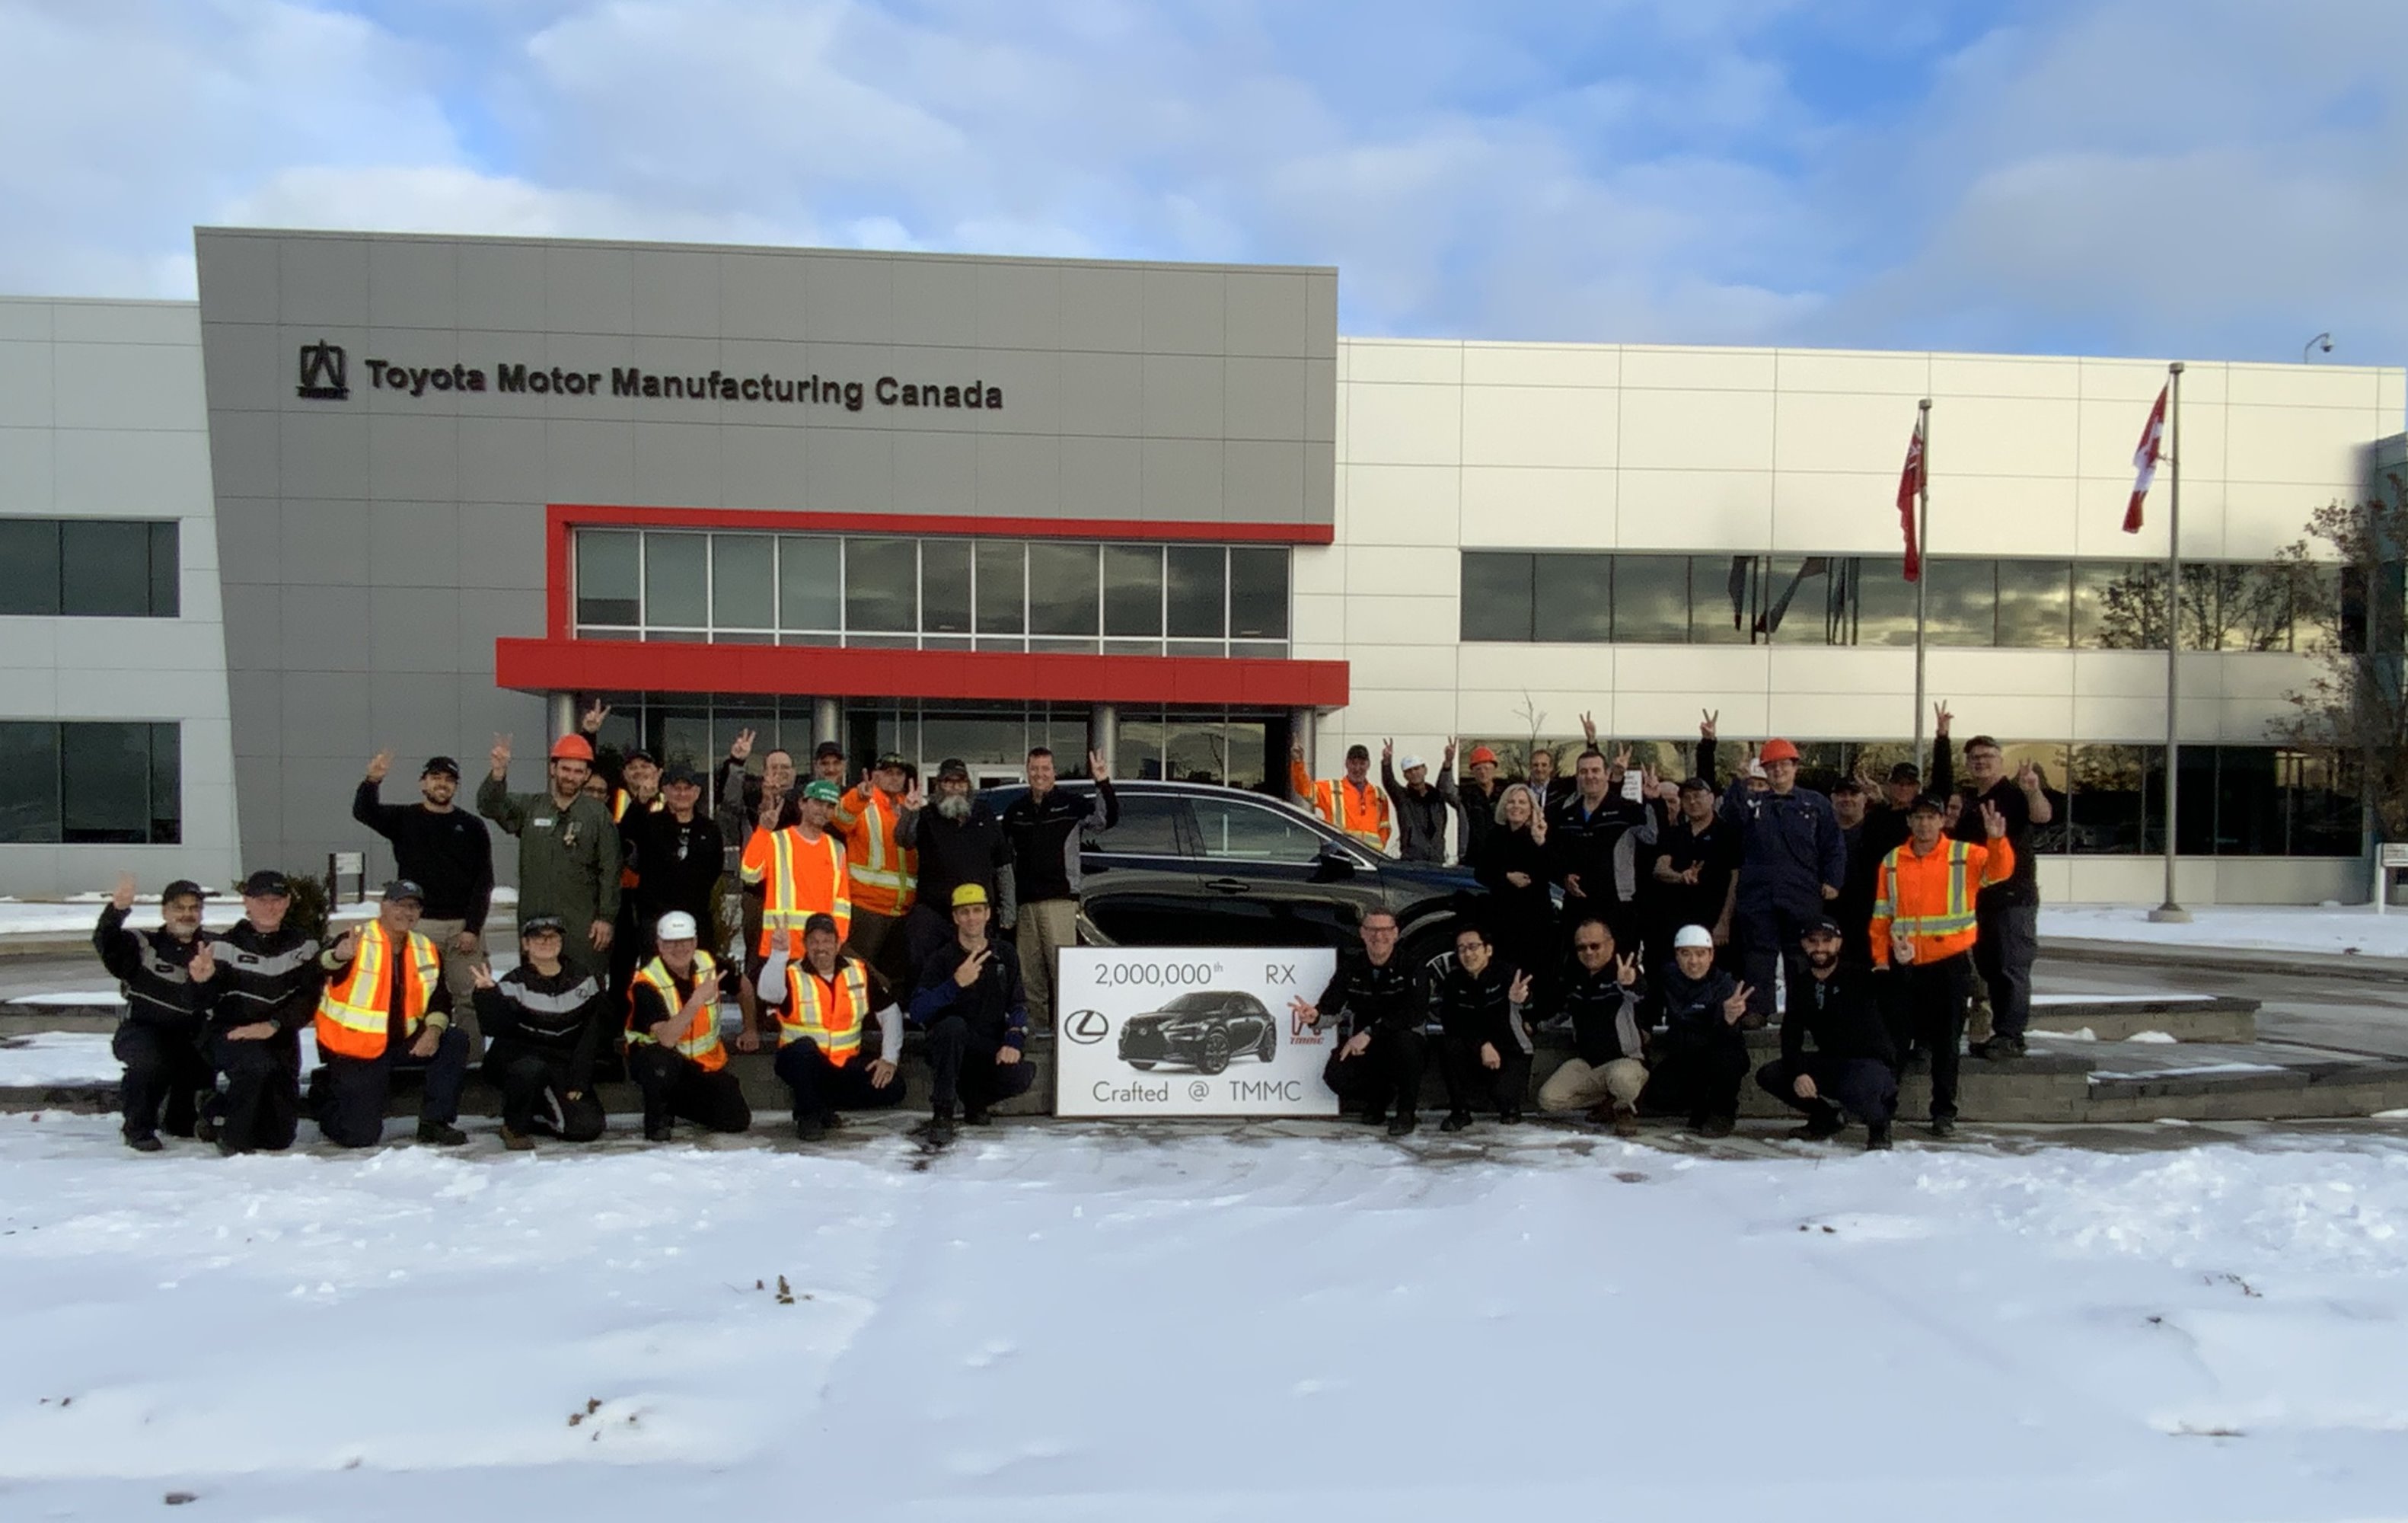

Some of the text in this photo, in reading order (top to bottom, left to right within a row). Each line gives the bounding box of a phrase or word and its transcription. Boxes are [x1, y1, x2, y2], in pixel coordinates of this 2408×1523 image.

[364, 359, 486, 398] Toyota
[498, 363, 601, 395] Motor
[611, 367, 863, 412] Manufacturing
[875, 376, 1003, 410] Canada
[1265, 964, 1296, 985] RX
[1092, 1080, 1302, 1103] Crafted @ TMMC
